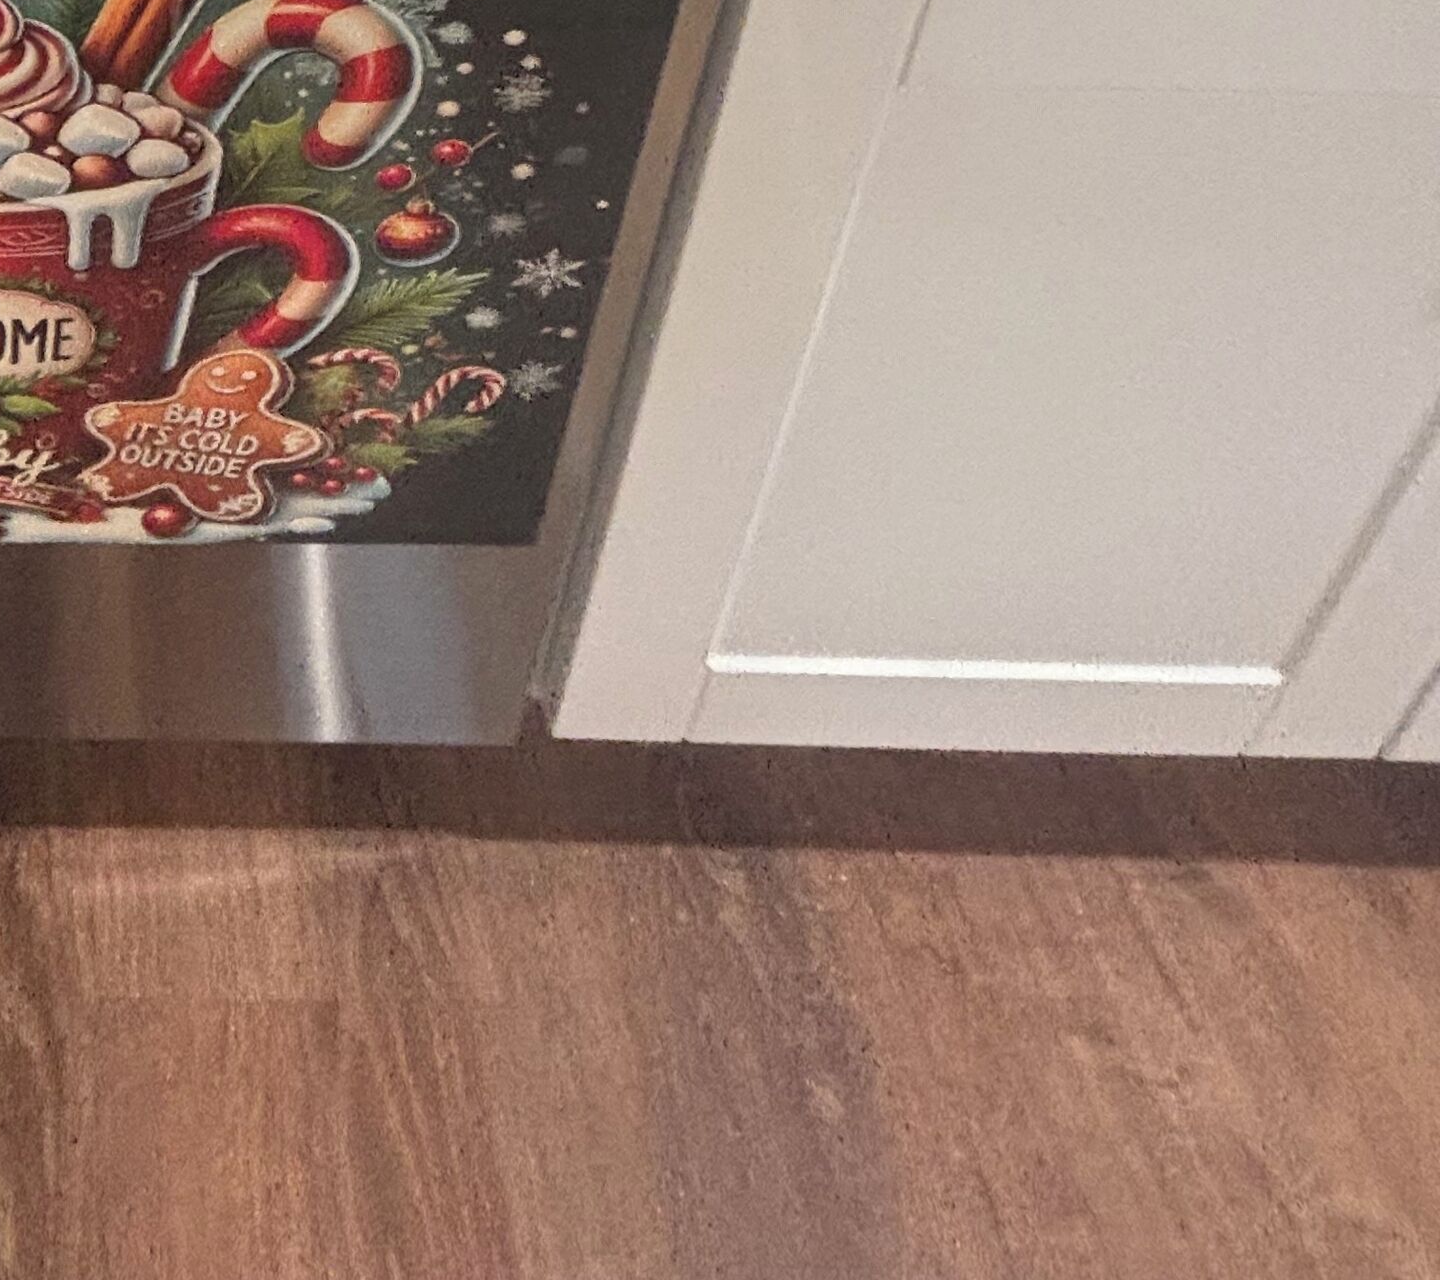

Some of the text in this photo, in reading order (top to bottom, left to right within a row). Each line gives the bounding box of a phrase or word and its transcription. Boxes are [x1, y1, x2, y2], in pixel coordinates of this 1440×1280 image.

[163, 403, 251, 430] BABY
[179, 429, 259, 456] COLD
[120, 444, 246, 478] OUTSIDE
